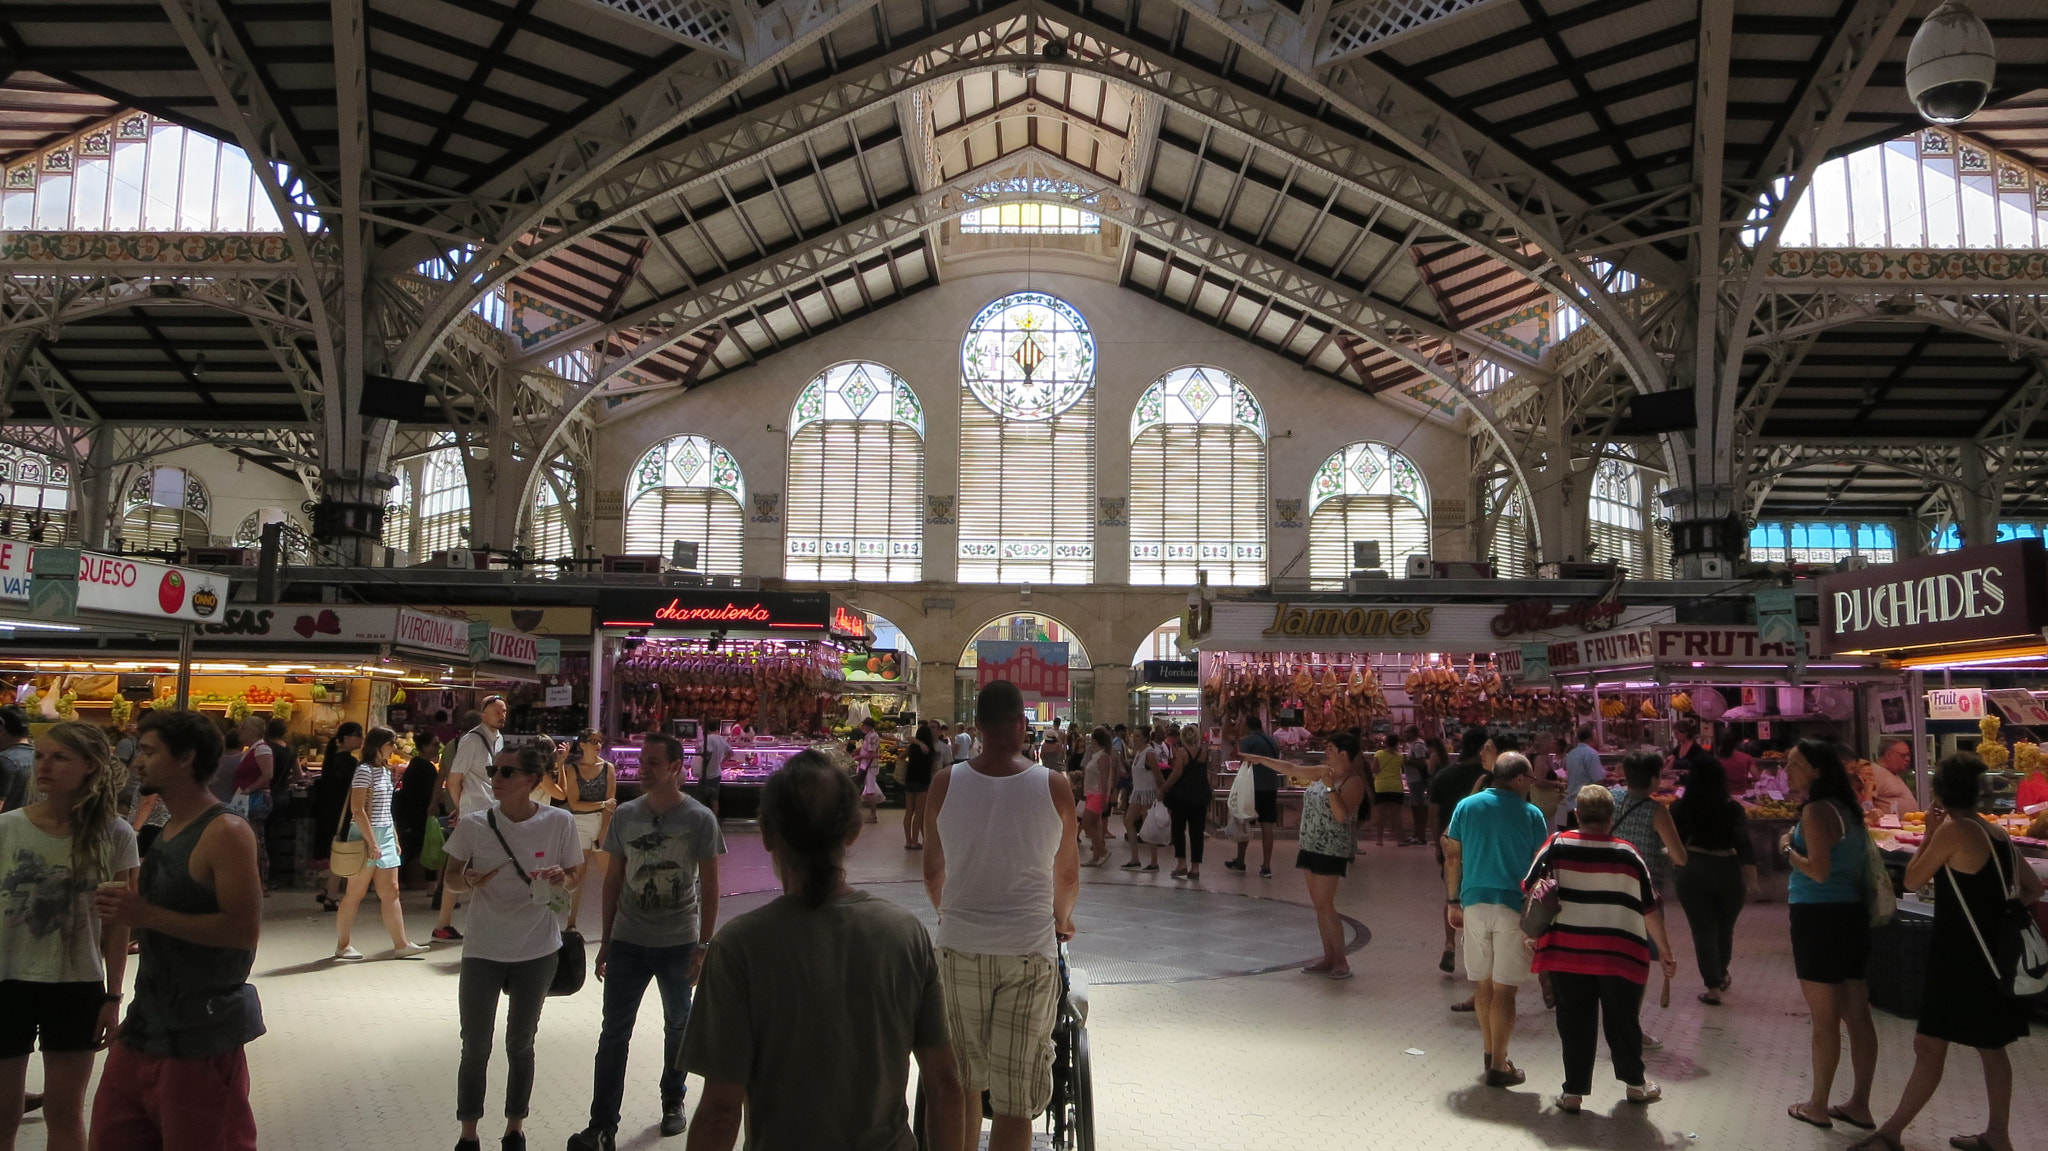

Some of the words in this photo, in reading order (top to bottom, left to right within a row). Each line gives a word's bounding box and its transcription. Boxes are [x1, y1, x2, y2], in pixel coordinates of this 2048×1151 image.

[79, 556, 136, 587] QUESO
[655, 598, 770, 621] charcutería
[1833, 566, 2005, 634] PUCHADES
[194, 609, 274, 636] SAS
[401, 614, 453, 646] VIRGINIA
[1262, 602, 1434, 636] Jamones
[490, 631, 536, 660] VIRGIN
[1497, 650, 1522, 672] FRU
[1584, 631, 1653, 663] FRUTAS
[1930, 691, 1957, 706] Fruit
